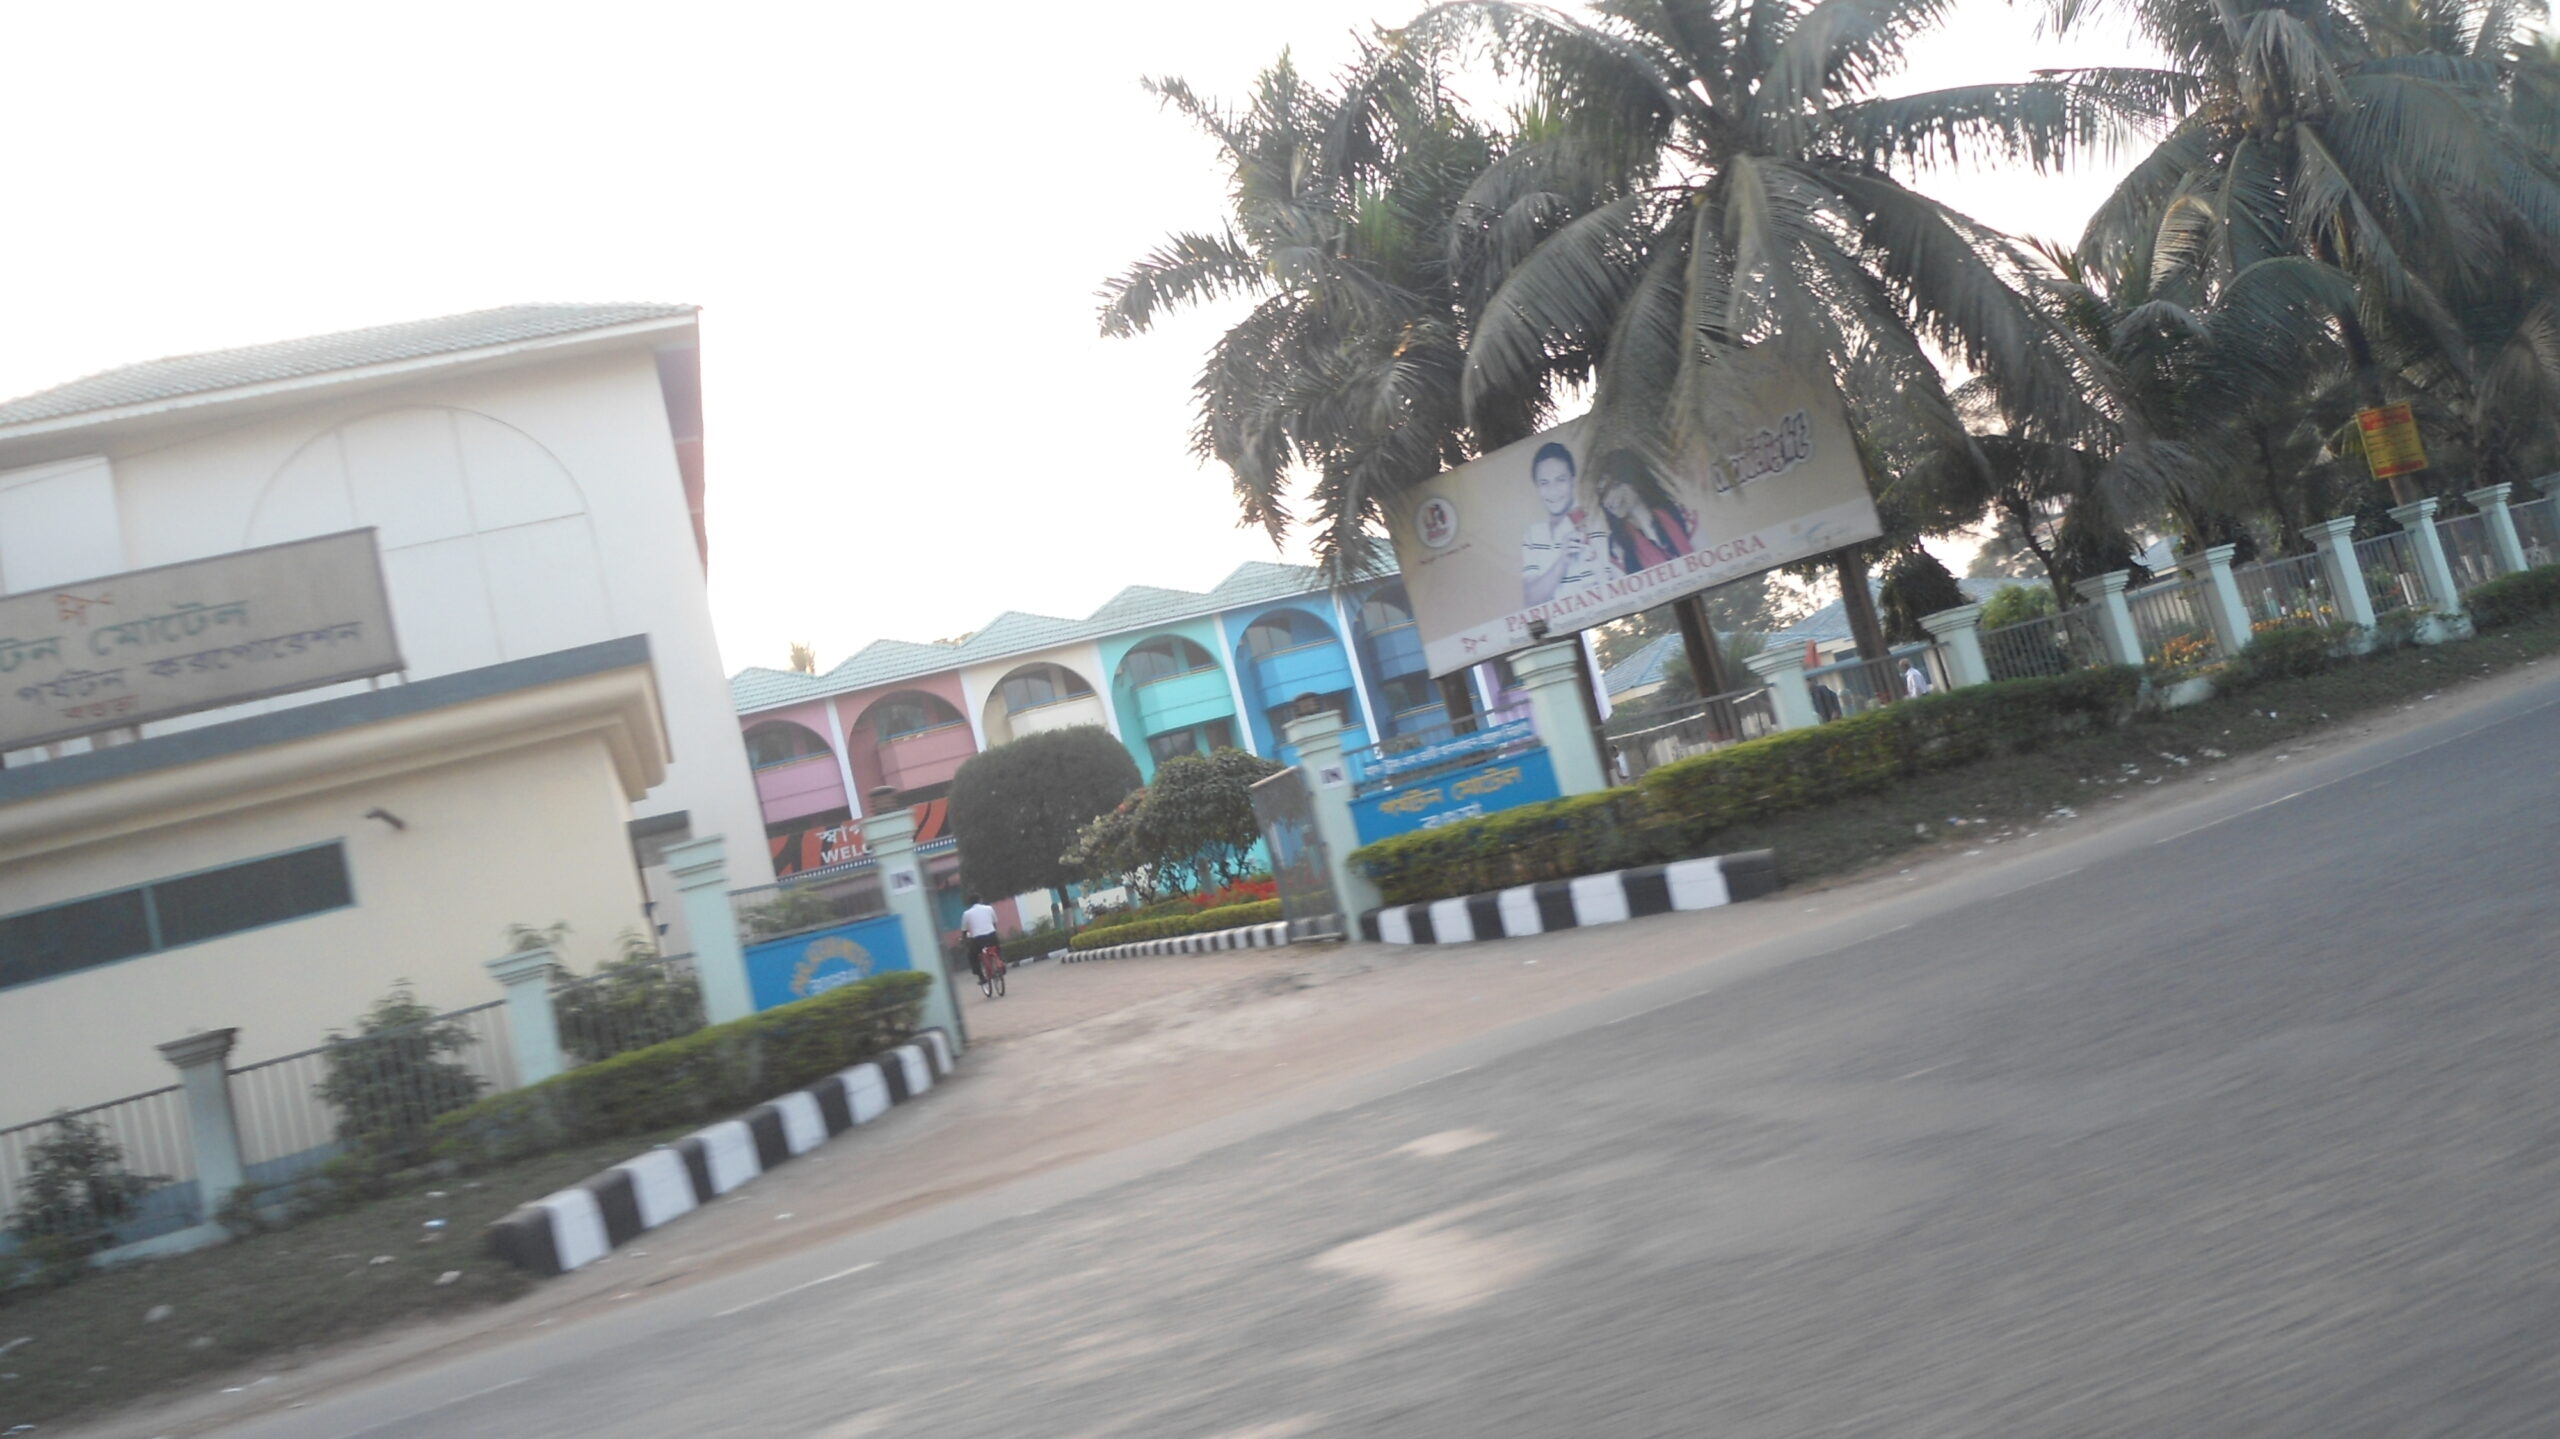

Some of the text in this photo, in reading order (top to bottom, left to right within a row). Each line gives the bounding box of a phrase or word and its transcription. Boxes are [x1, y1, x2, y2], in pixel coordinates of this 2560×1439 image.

[1504, 585, 1604, 632] PARJATAN
[1606, 563, 1680, 599] MOTEL
[1684, 534, 1766, 573] BOGRA
[88, 600, 250, 656] মোটেল
[821, 843, 874, 864] WELC
